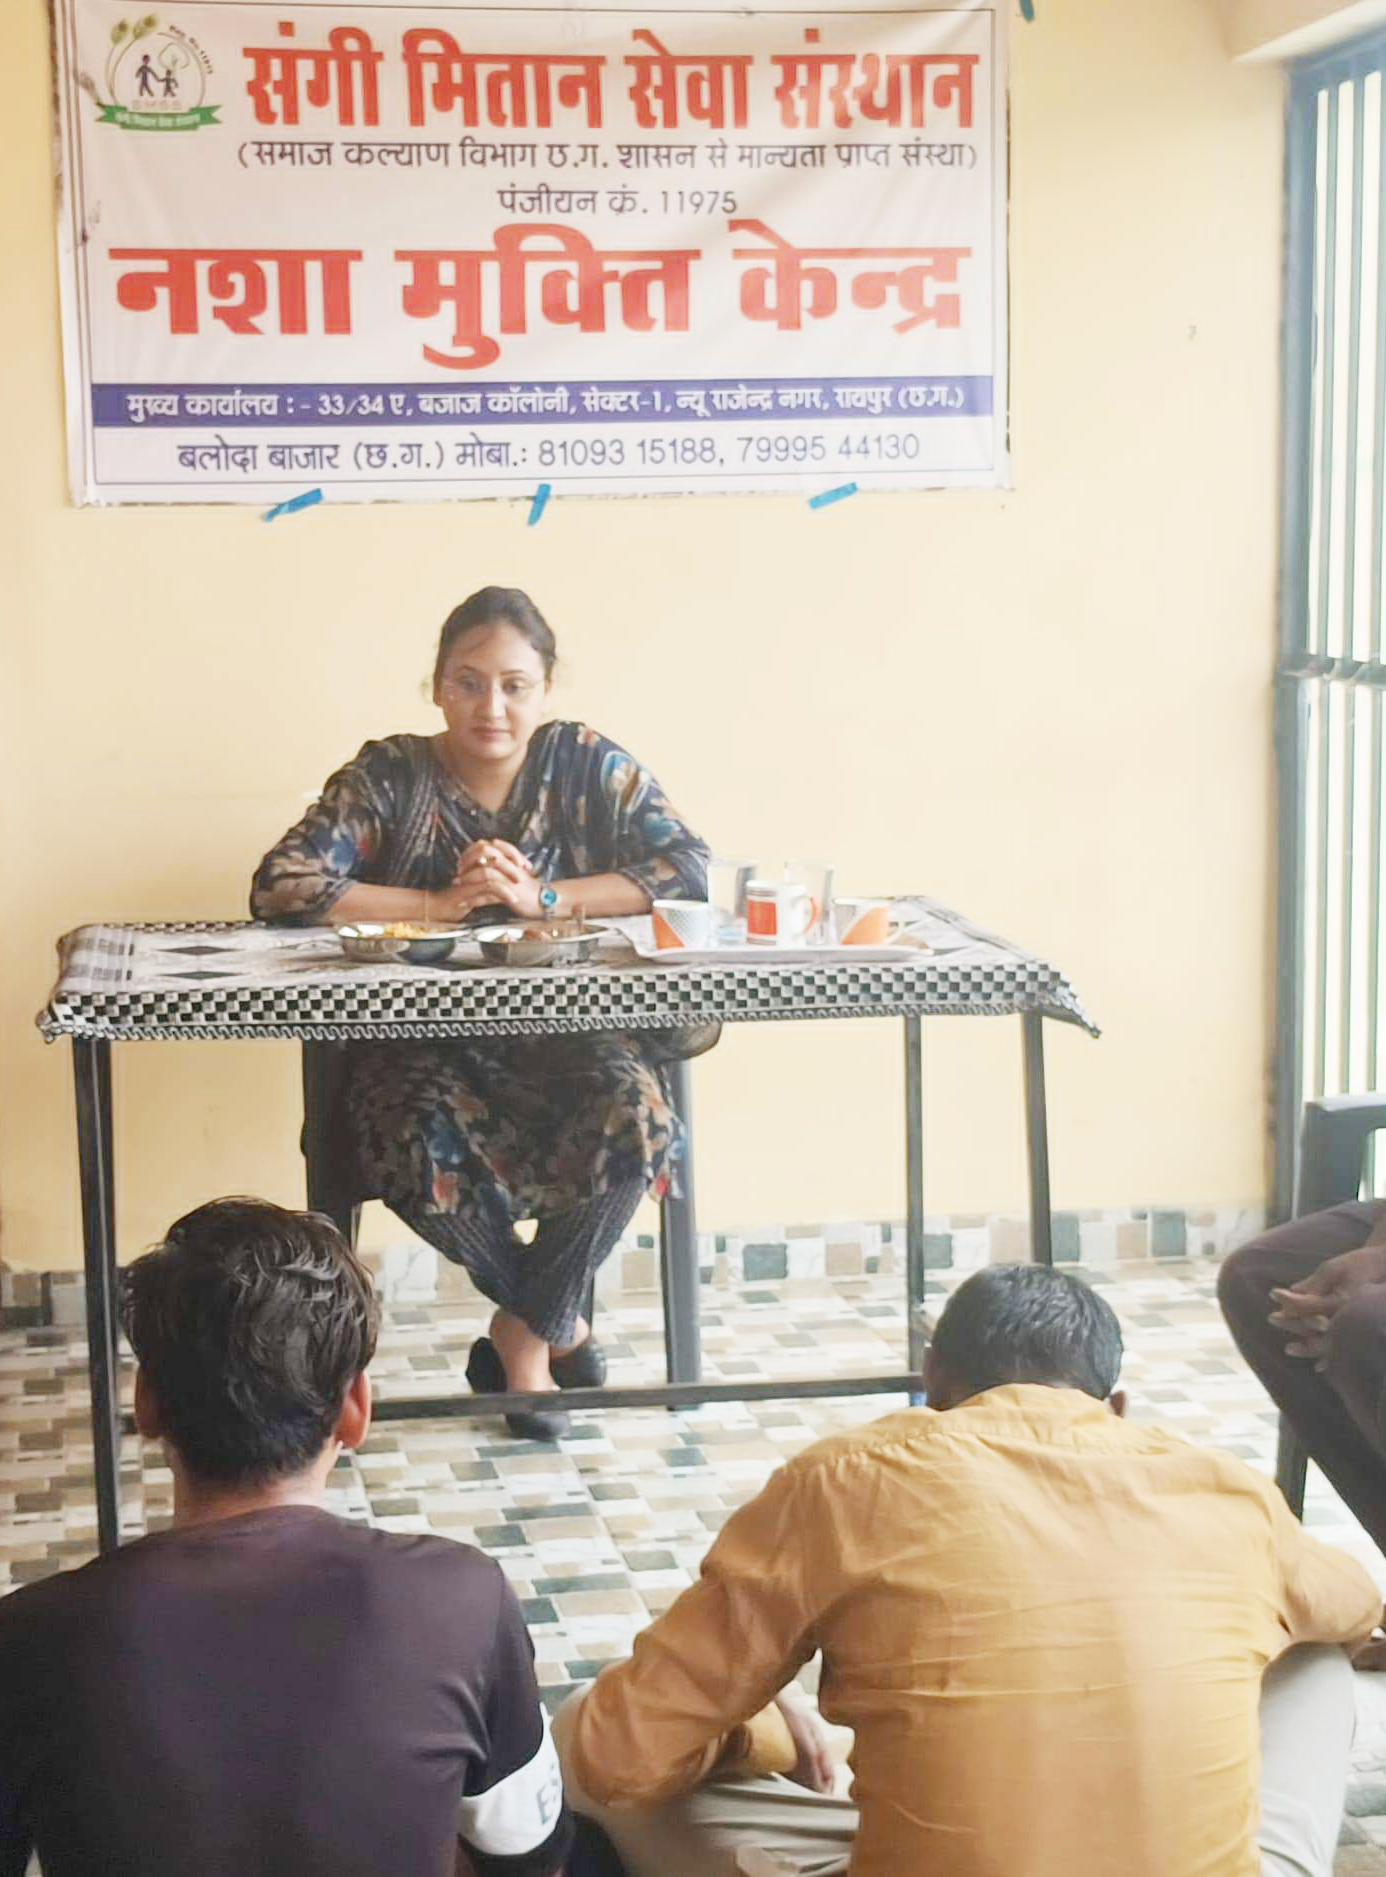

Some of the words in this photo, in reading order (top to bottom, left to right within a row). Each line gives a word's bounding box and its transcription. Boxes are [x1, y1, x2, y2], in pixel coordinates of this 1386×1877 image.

[242, 22, 383, 128] संगी
[401, 27, 607, 128] मितान
[624, 28, 755, 129] सेवा
[770, 28, 980, 129] संस्थान
[237, 140, 333, 168] (समाज
[341, 142, 450, 168] कल्याण
[459, 136, 536, 168] विभाग
[616, 144, 697, 168] शासन
[707, 138, 727, 168] से
[738, 144, 825, 168] मान्यता
[834, 143, 890, 169] प्राप्त
[899, 137, 977, 169] संस्था)
[497, 183, 598, 214] पंजीयन
[662, 190, 737, 214] 11975
[109, 248, 363, 336] नशा
[395, 223, 701, 369] मुक्ति
[727, 219, 972, 335] केन्द्र
[125, 393, 178, 423] मुख्य
[185, 391, 278, 416] कार्यालय
[318, 393, 383, 415] 33/34
[417, 393, 480, 415] बजाज
[488, 386, 576, 415] कॉलोनी,
[675, 389, 711, 417] न्यू
[712, 384, 773, 413] राजेन्द्र
[777, 388, 829, 412] नगर,
[835, 387, 892, 417] रायपुर
[177, 434, 258, 470] बलोदा
[267, 444, 340, 469] बाजार
[353, 441, 444, 471] (छ.ग.)
[538, 439, 625, 466] 81093
[637, 438, 724, 466] 15188,
[737, 435, 826, 462] 79995
[838, 434, 919, 460] 44130
